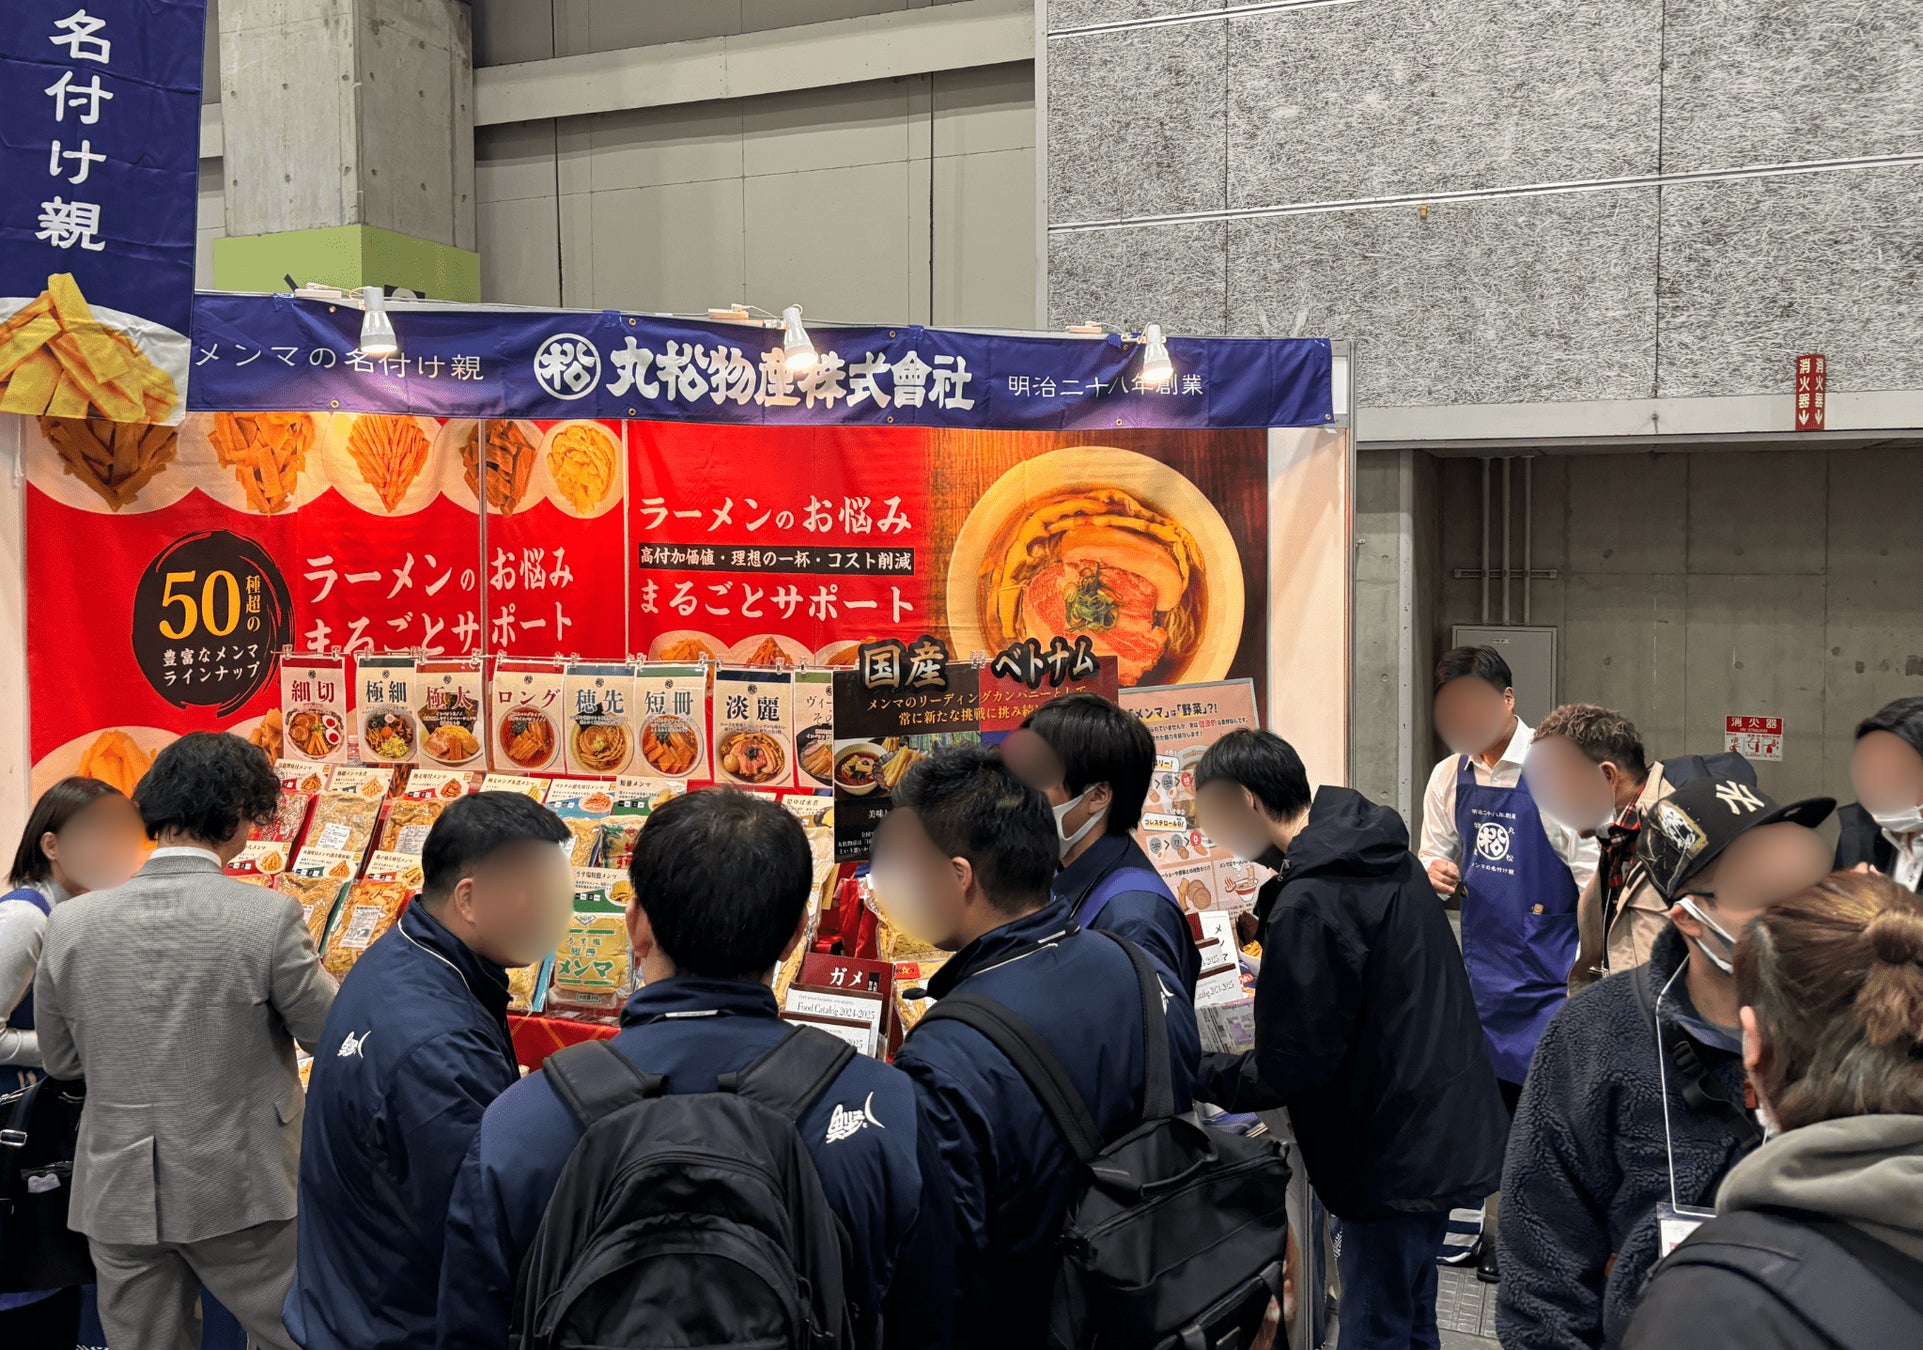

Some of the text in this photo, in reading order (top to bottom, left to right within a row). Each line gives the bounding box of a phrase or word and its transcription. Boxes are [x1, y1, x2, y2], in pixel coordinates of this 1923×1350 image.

[35, 8, 114, 252] 名付け親
[194, 342, 485, 381] メンマの名付け親
[605, 336, 975, 411] 丸松物産株式會社
[1008, 373, 1204, 398] 明治二十八年創業
[1799, 358, 1811, 409] 消火器
[1815, 357, 1824, 408] 消火器
[639, 495, 912, 535] ラーメンのお悩み
[640, 548, 912, 571] 高付加価値・理想の一杯・コスト削減
[303, 546, 574, 604] ラーメンのお悩み
[158, 569, 241, 641] 50
[245, 575, 261, 632] 種超の
[640, 580, 914, 624] まるごとサポート
[162, 644, 259, 668] 豊富なメンマ
[863, 641, 946, 689] 国産
[995, 640, 1095, 683] ベトナム
[163, 662, 260, 686] ラインナップ
[291, 680, 335, 703] 細切
[366, 680, 407, 703] 極細
[426, 686, 473, 710] 極太
[498, 688, 560, 709] ロング
[576, 688, 624, 714] 穂先
[645, 691, 694, 716] 短冊
[726, 695, 780, 722] 淡麗
[898, 704, 1039, 726] 常に新たな挑戦に挑み続
[1731, 717, 1777, 728] 消火器
[1715, 780, 1765, 816] NY
[557, 958, 614, 978] メンマ
[797, 1002, 814, 1012] Food
